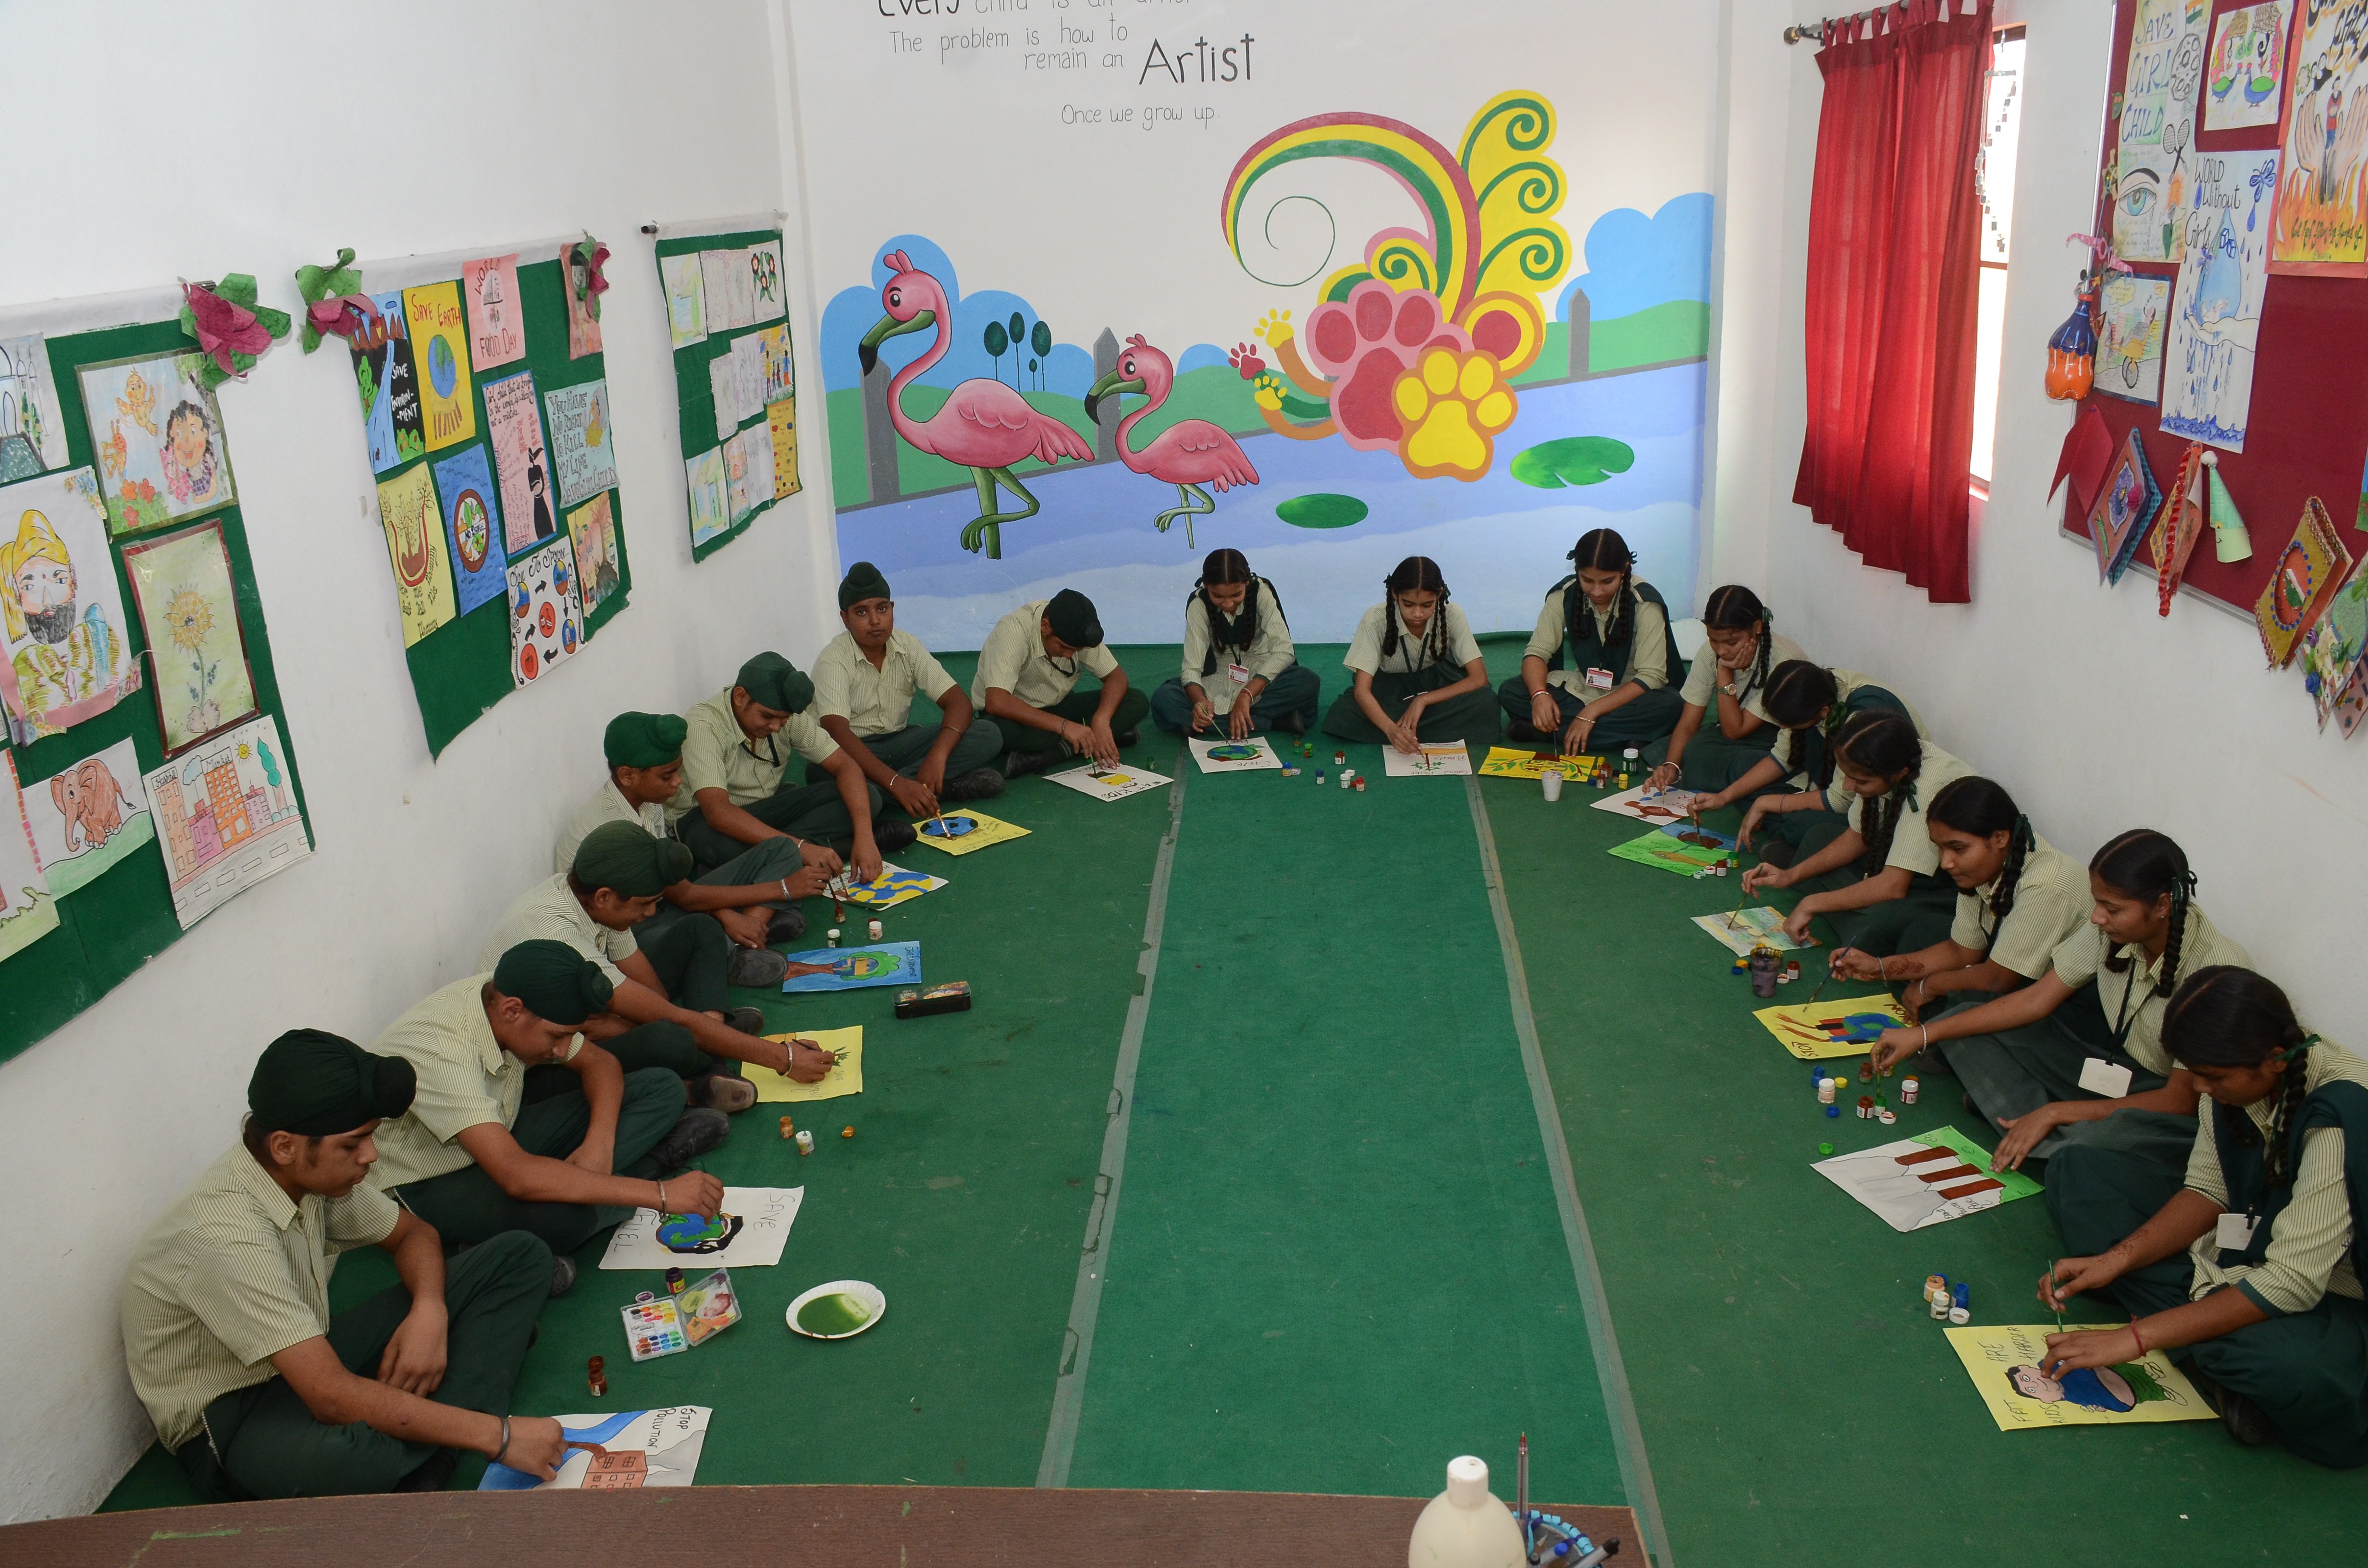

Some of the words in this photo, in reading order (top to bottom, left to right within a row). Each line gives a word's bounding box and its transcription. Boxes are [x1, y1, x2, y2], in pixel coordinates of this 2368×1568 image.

[2135, 0, 2173, 44] SAVE
[889, 31, 922, 53] The
[940, 27, 1009, 64] problem
[1025, 27, 1040, 45] is
[1061, 17, 1095, 44] how
[1110, 13, 1128, 41] to
[1024, 49, 1087, 71] remain
[1103, 54, 1124, 68] an
[1139, 33, 1255, 85] Artist
[2129, 49, 2171, 98] GIRL
[1061, 104, 1101, 124] Once
[1110, 109, 1133, 122] we
[1144, 107, 1183, 130] grow
[2122, 102, 2163, 142] CHILD
[2194, 157, 2224, 183] WORLD
[475, 259, 500, 296] WORLD
[412, 294, 433, 322] SAVE
[437, 306, 461, 329] EARTH
[480, 335, 501, 357] FOOD
[392, 362, 408, 380] SAVE
[548, 395, 566, 415] YOU
[567, 391, 587, 412] HAVE
[564, 413, 582, 433] RIGHT
[563, 433, 583, 455] KILL
[557, 460, 568, 480] MY
[570, 453, 588, 475] LIFE
[1791, 1041, 1819, 1058] STOP
[753, 1194, 795, 1230] SAVE
[1977, 1341, 2005, 1363] ARE
[677, 1408, 696, 1430] STOP
[2003, 1400, 2033, 1422] FAT
[2039, 1404, 2067, 1423] KIDS
[647, 1408, 677, 1448] POLLUTION
